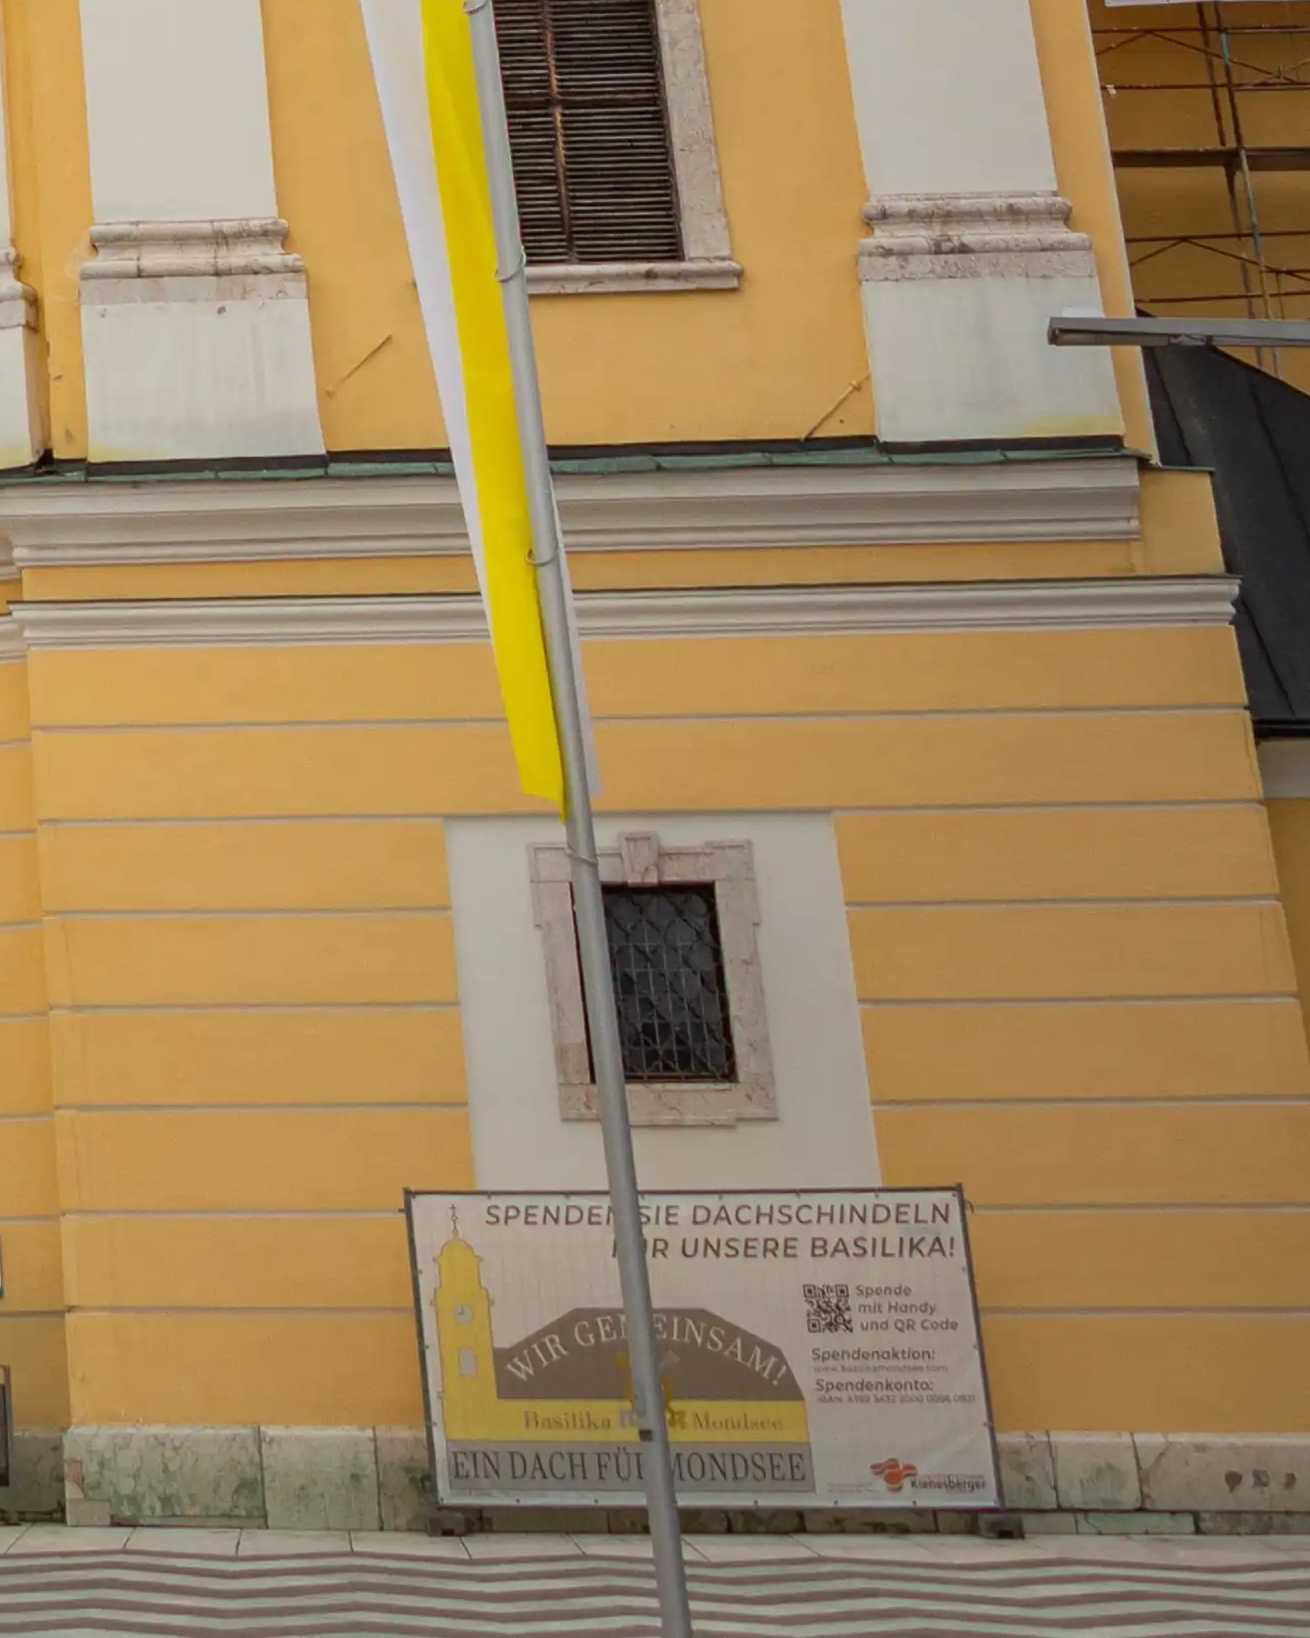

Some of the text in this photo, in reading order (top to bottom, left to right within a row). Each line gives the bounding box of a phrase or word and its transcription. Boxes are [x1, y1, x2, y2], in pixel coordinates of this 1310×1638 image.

[637, 1204, 681, 1226] SIE
[691, 1202, 951, 1226] DACHSCHINDELN
[681, 1237, 799, 1259] UNSERE
[810, 1235, 955, 1259] BASILIKA!
[855, 1284, 912, 1299] Spende
[857, 1301, 937, 1315] mit Handy
[859, 1318, 959, 1333] und QR Code
[506, 1333, 570, 1381] WIR
[811, 1347, 936, 1363] Spendenaktion:
[815, 1379, 934, 1393] Spendenkonto:
[524, 1410, 612, 1431] Basilika
[452, 1451, 501, 1480] EIN
[507, 1450, 592, 1480] DACH
